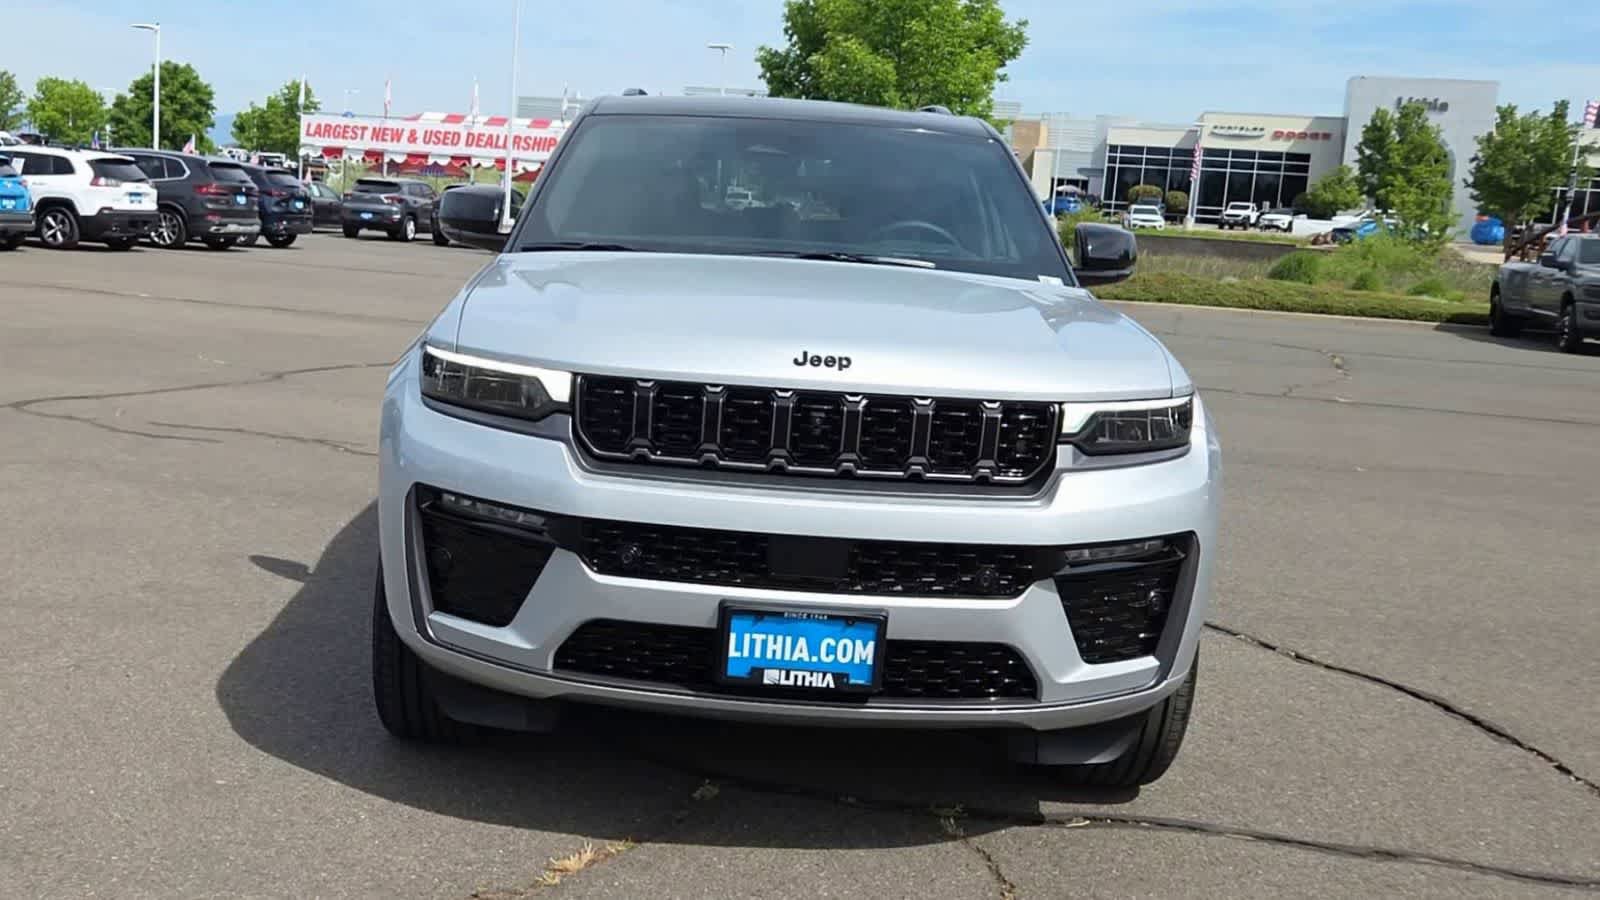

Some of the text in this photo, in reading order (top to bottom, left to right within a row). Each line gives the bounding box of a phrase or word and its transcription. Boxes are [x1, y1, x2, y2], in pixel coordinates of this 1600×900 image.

[1396, 96, 1449, 112] Lhia
[305, 122, 368, 140] LARGEST
[370, 127, 404, 144] NEW
[407, 130, 419, 145] &
[423, 130, 461, 147] USED
[793, 350, 852, 371] Jeep
[728, 632, 875, 665] LITHIA.COM
[780, 669, 836, 689] LITHIA
